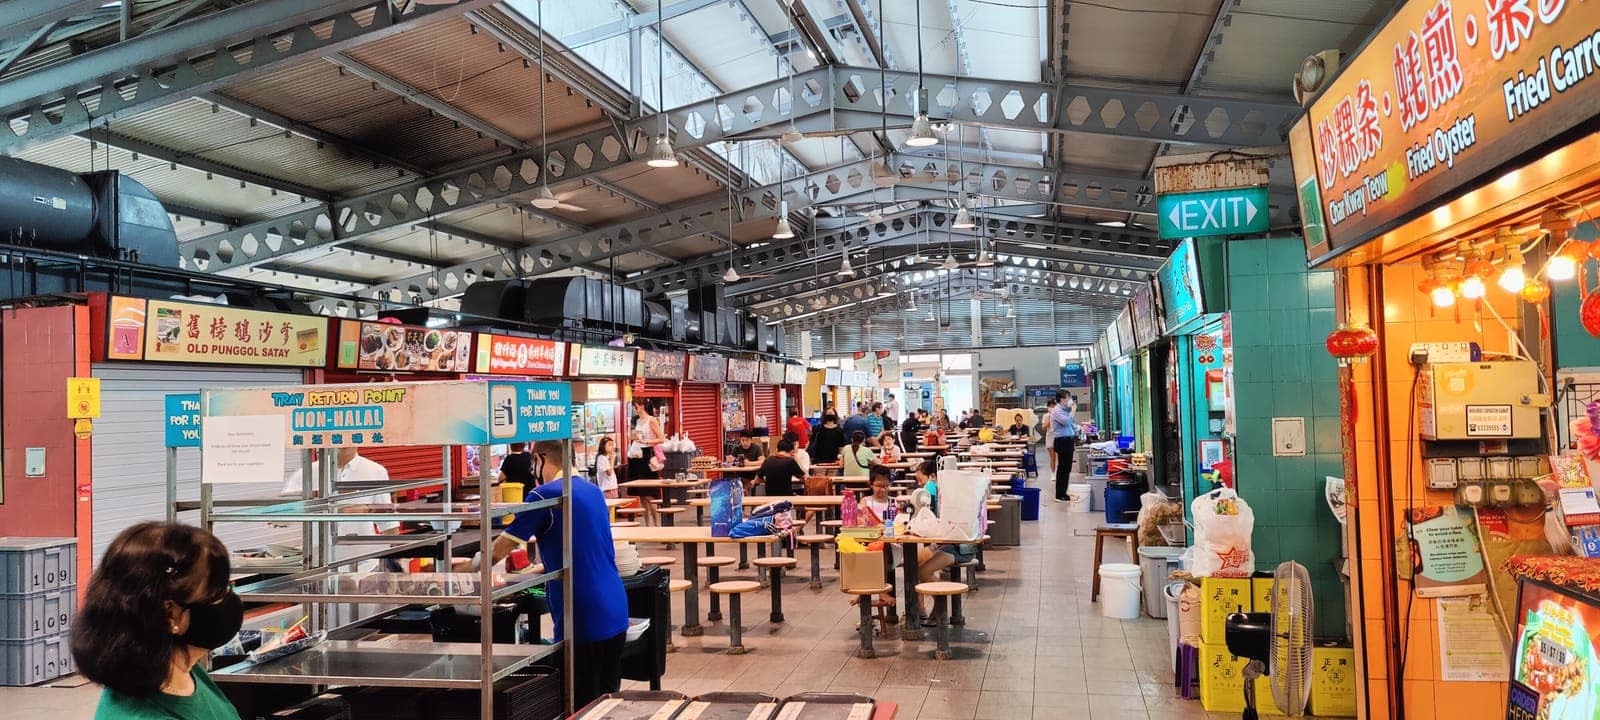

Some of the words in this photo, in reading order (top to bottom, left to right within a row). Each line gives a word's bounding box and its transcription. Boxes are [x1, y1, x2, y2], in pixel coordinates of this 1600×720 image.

[1503, 56, 1551, 121] Fried
[1405, 134, 1435, 180] Fried
[1434, 113, 1475, 169] Oyster
[1329, 198, 1345, 225] Char
[1344, 184, 1367, 216] Kway
[1364, 170, 1388, 203] Teow
[1182, 196, 1244, 231] EXIT
[187, 343, 208, 354] OLD
[212, 345, 260, 357] PUNGGOL
[262, 348, 290, 358] SATAY
[272, 393, 304, 407] TRAY
[308, 390, 359, 406] RETURN
[364, 388, 406, 404] POINT
[527, 388, 547, 401] THANK
[548, 389, 560, 400] YOU
[295, 409, 382, 428] NON-HALAL
[520, 405, 532, 417] FOR
[534, 404, 566, 417] RETURNING
[170, 415, 189, 425] FOR
[528, 421, 545, 433] YOUR
[545, 420, 560, 432] TRAY
[34, 569, 67, 586] 109
[34, 614, 68, 631] 109
[1511, 687, 1536, 714] ORDER
